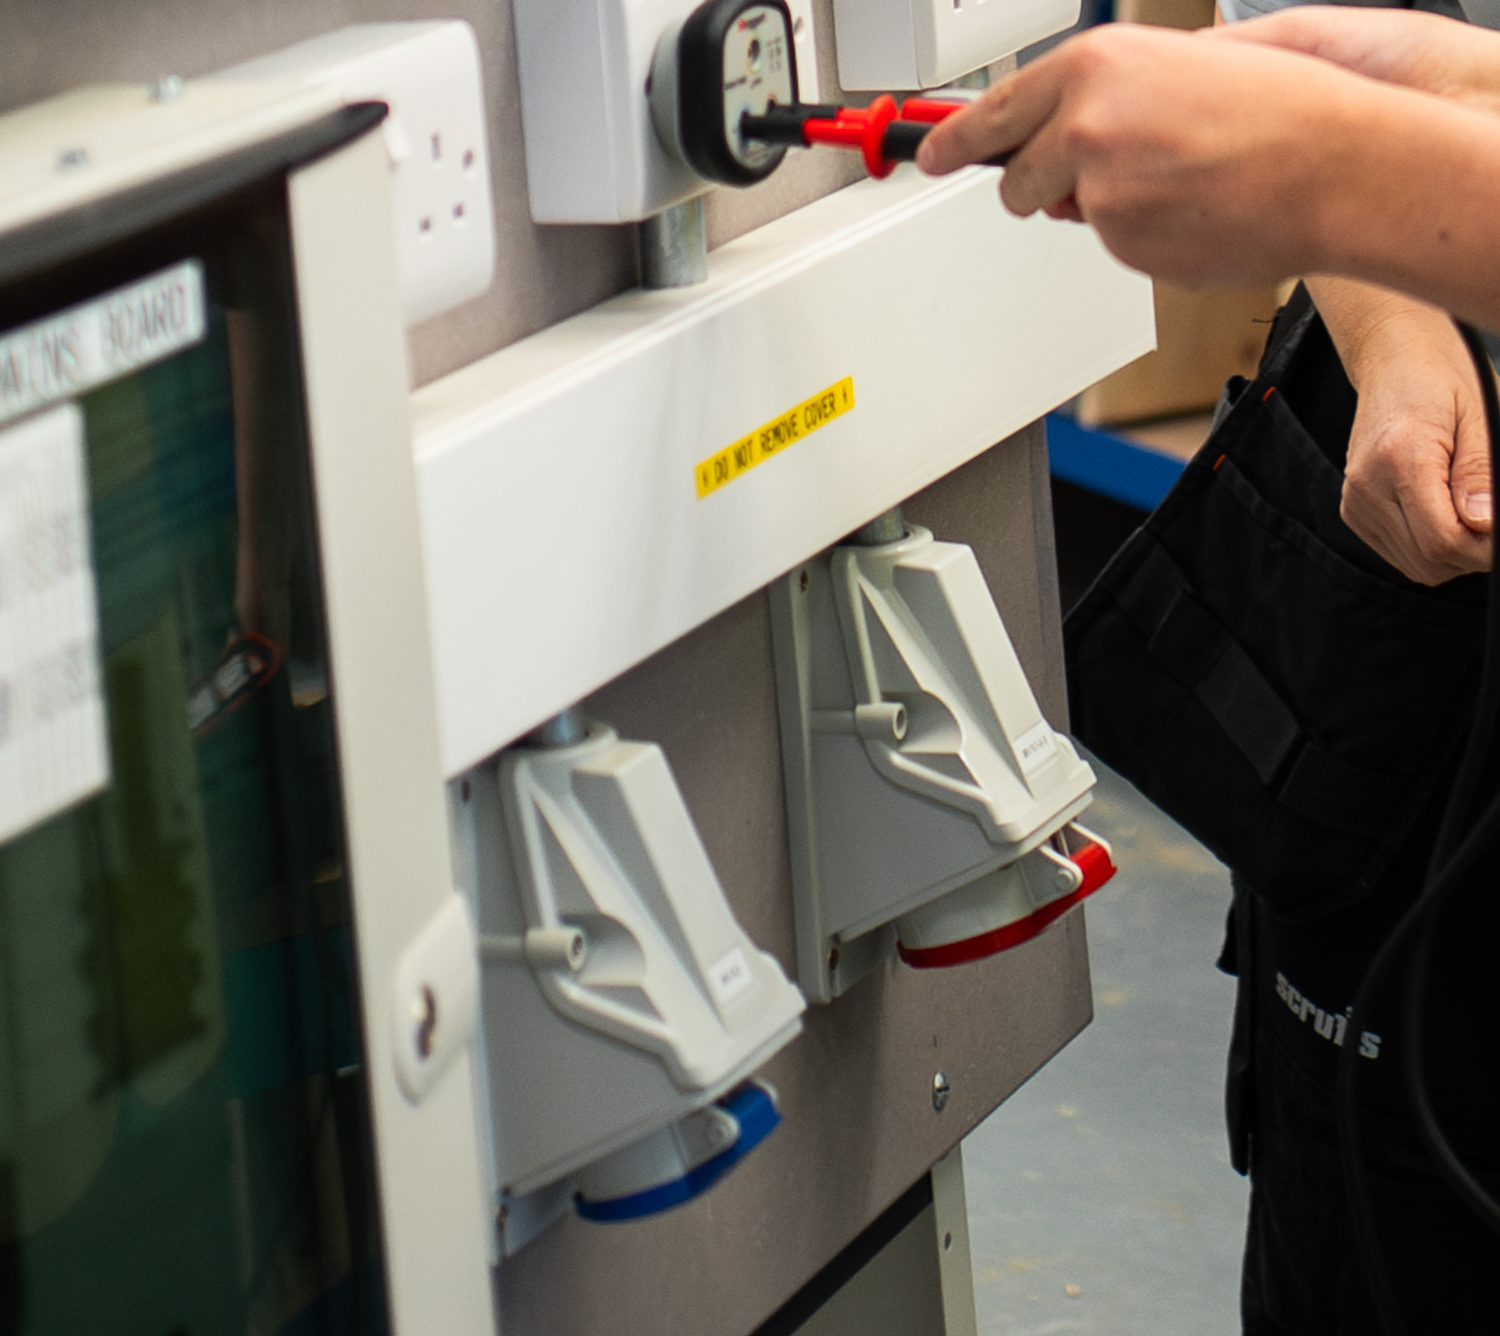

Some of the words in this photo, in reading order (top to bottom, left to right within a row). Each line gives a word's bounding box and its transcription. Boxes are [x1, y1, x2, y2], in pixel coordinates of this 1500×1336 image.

[713, 456, 729, 485] DO
[733, 438, 754, 470] NOT
[759, 413, 800, 453] REMOVE
[803, 391, 837, 430] COVER
